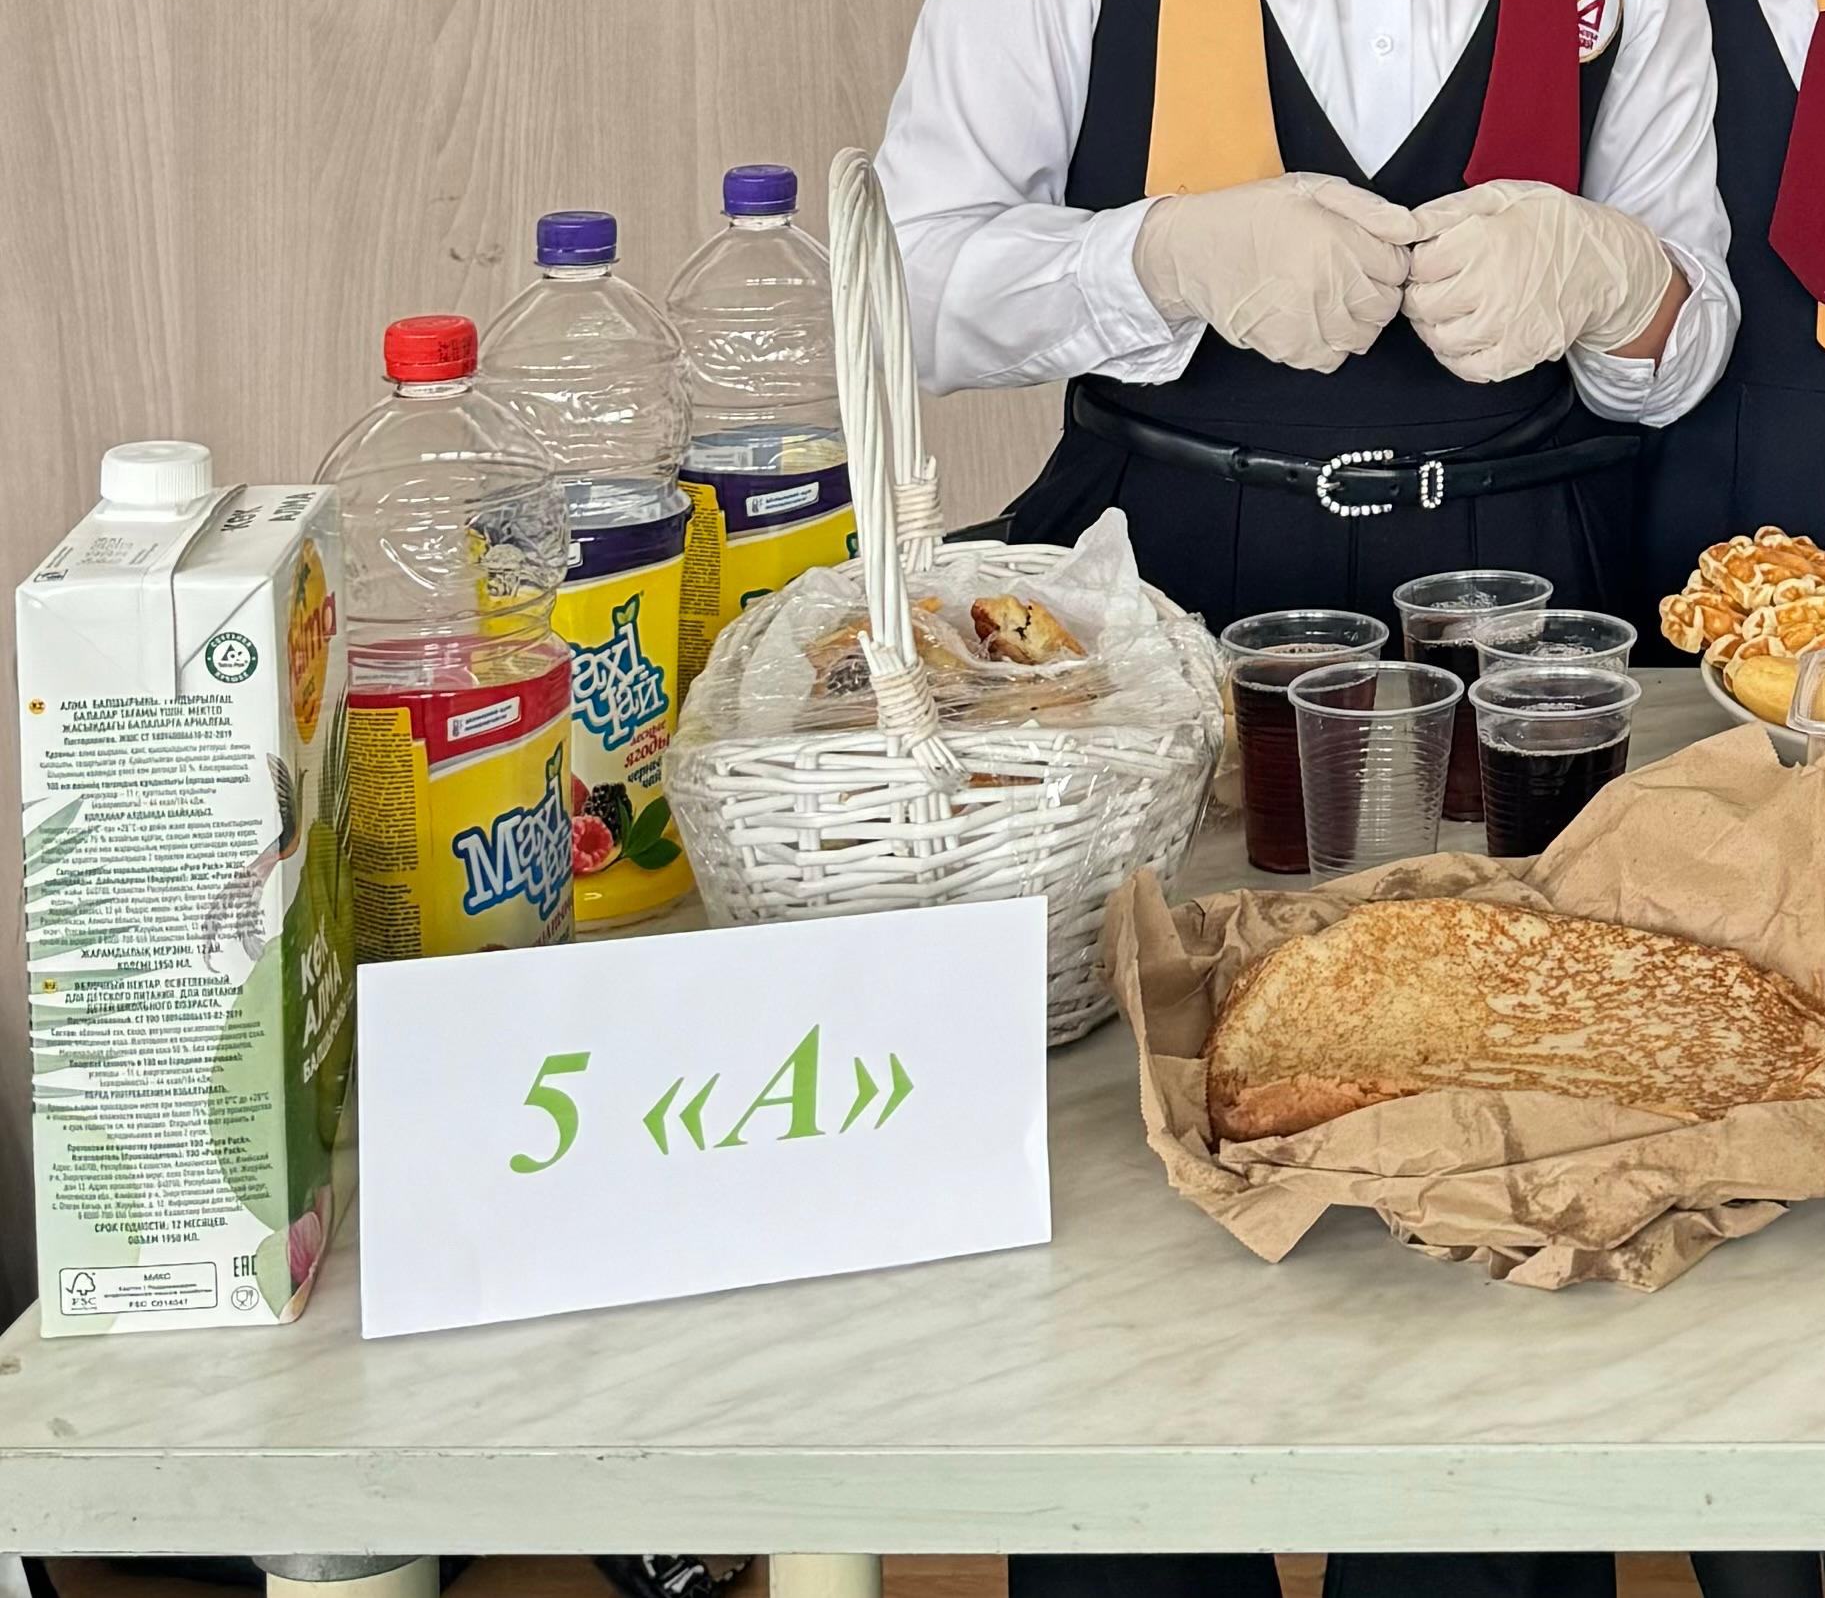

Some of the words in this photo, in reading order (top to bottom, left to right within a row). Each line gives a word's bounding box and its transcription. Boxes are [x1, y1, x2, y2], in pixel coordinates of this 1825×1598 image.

[87, 991, 131, 1003] ДЕТСКОГО
[509, 1050, 592, 1175] 5
[172, 1219, 180, 1229] 12
[162, 1233, 181, 1243] 1950
